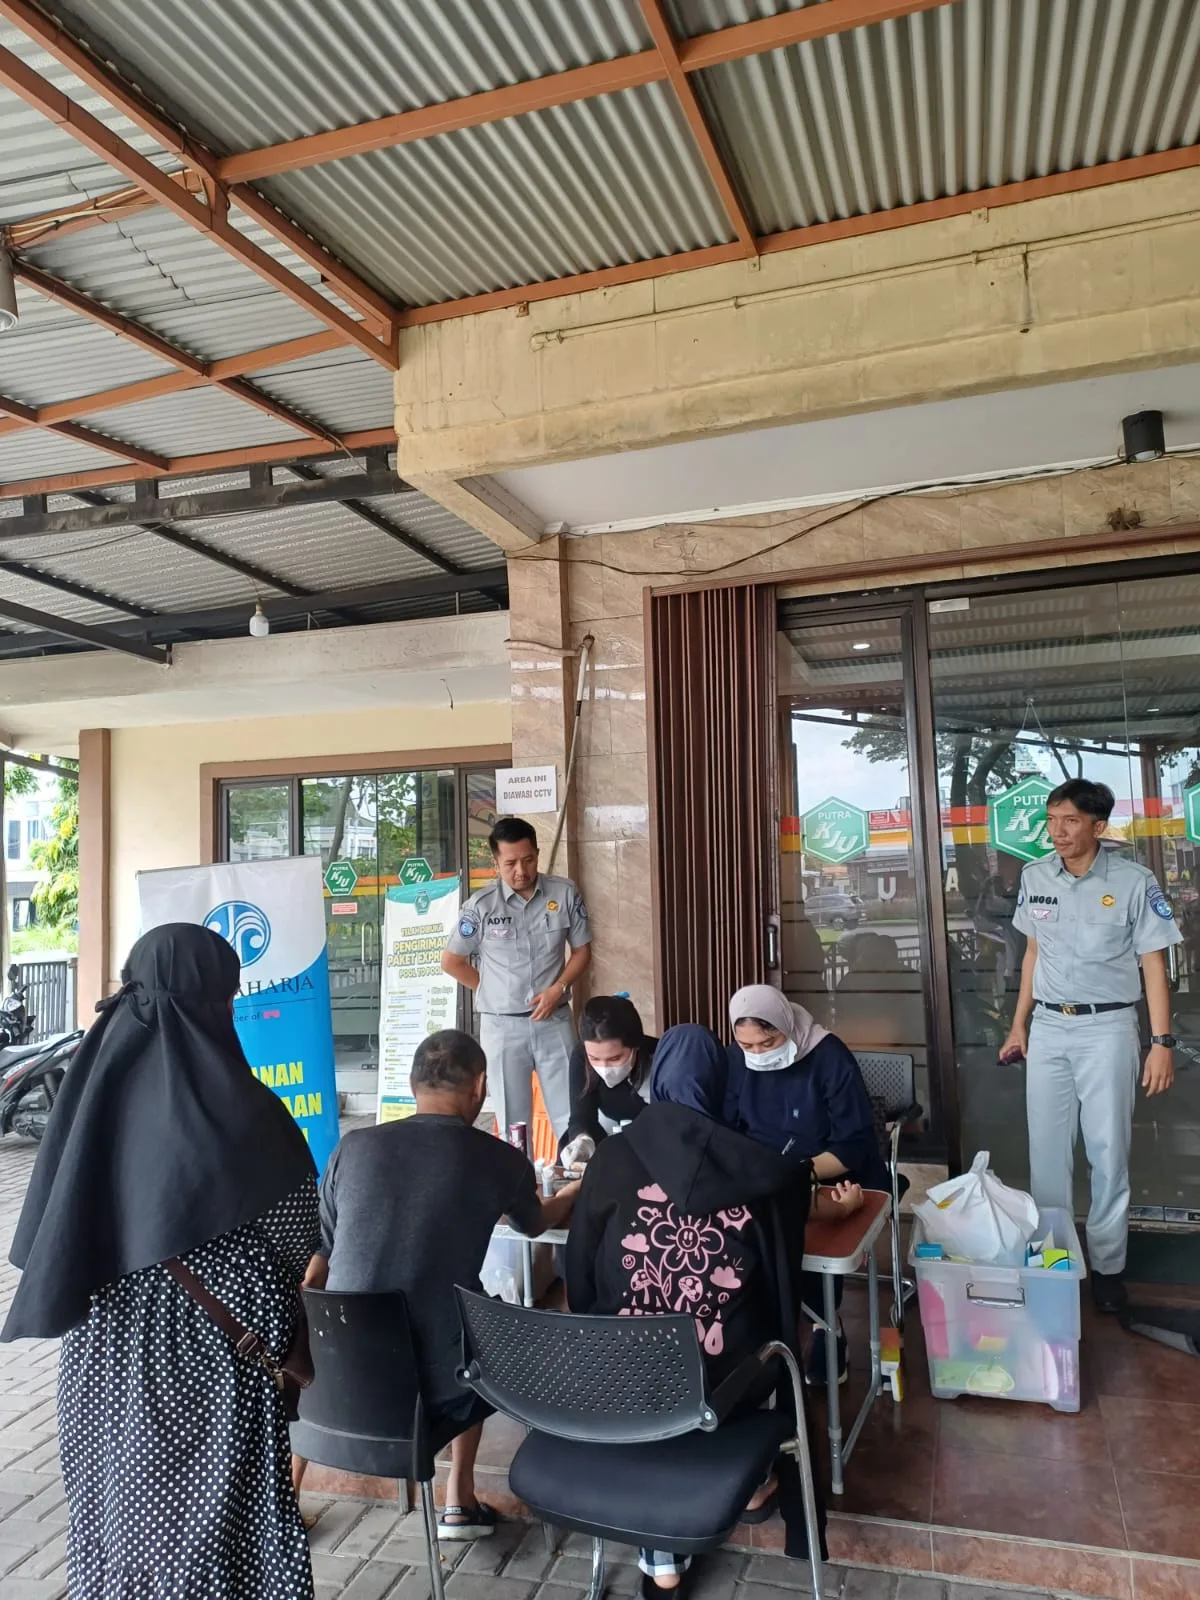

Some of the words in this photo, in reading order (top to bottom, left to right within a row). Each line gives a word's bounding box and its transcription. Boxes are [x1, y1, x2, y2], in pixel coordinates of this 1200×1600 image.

[508, 775, 532, 784] AREA
[534, 774, 547, 783] INI
[503, 790, 533, 800] DIAWASI
[534, 788, 552, 799] CCTV
[817, 810, 852, 820] PUTRA
[812, 821, 859, 853] KJU
[330, 871, 350, 887] KJU
[1029, 895, 1058, 905] ANGGA
[487, 916, 513, 926] ADYT
[393, 935, 448, 954] PENGIRIMAN
[387, 953, 416, 967] PAKET
